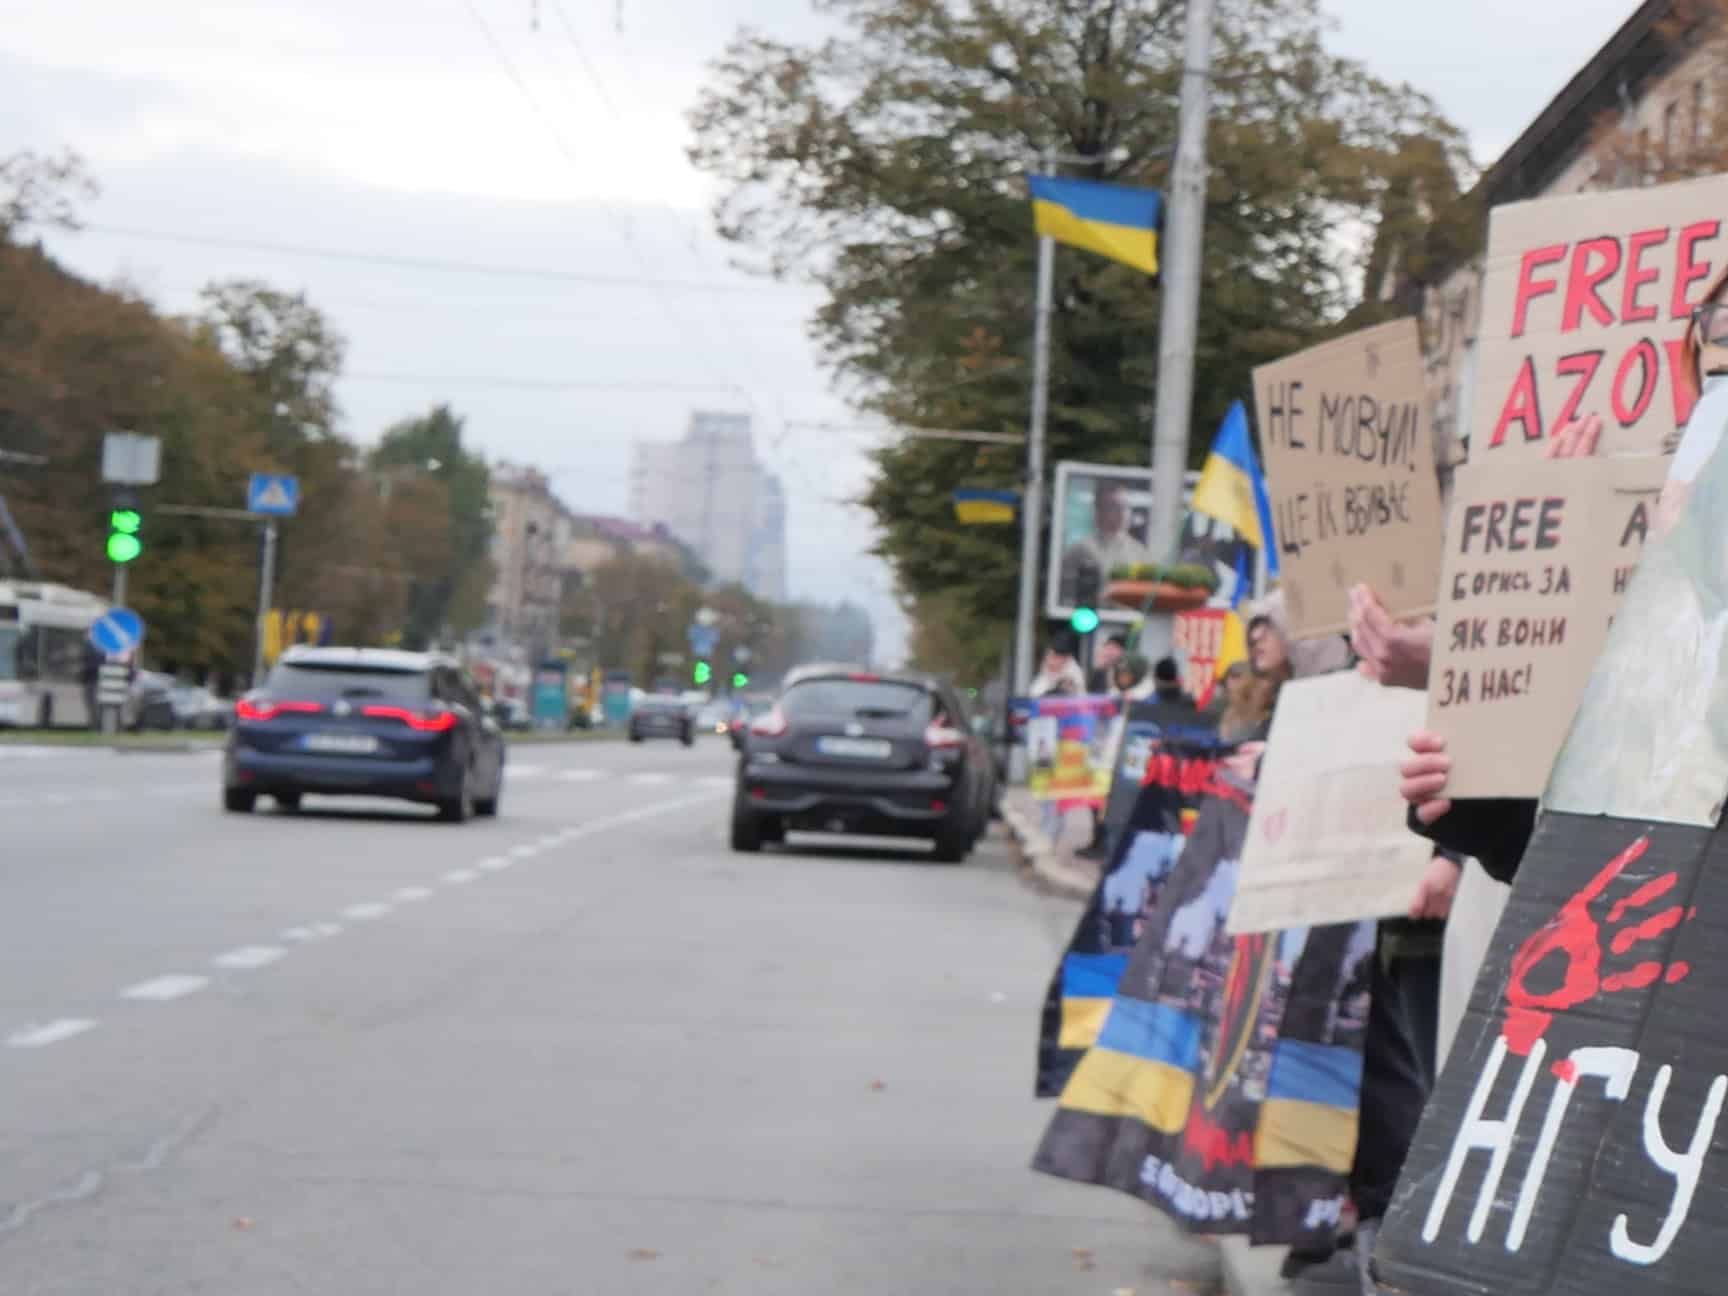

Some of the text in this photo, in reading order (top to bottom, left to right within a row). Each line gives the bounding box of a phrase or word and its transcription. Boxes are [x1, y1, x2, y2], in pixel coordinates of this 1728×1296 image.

[1510, 219, 1721, 338] FREE
[1268, 381, 1304, 449] НЕ
[1460, 497, 1565, 553] FREE
[1537, 565, 1571, 594] ЗА
[1449, 616, 1567, 652] ЯК ВОНИ
[1438, 663, 1533, 707] ЗА НАС!
